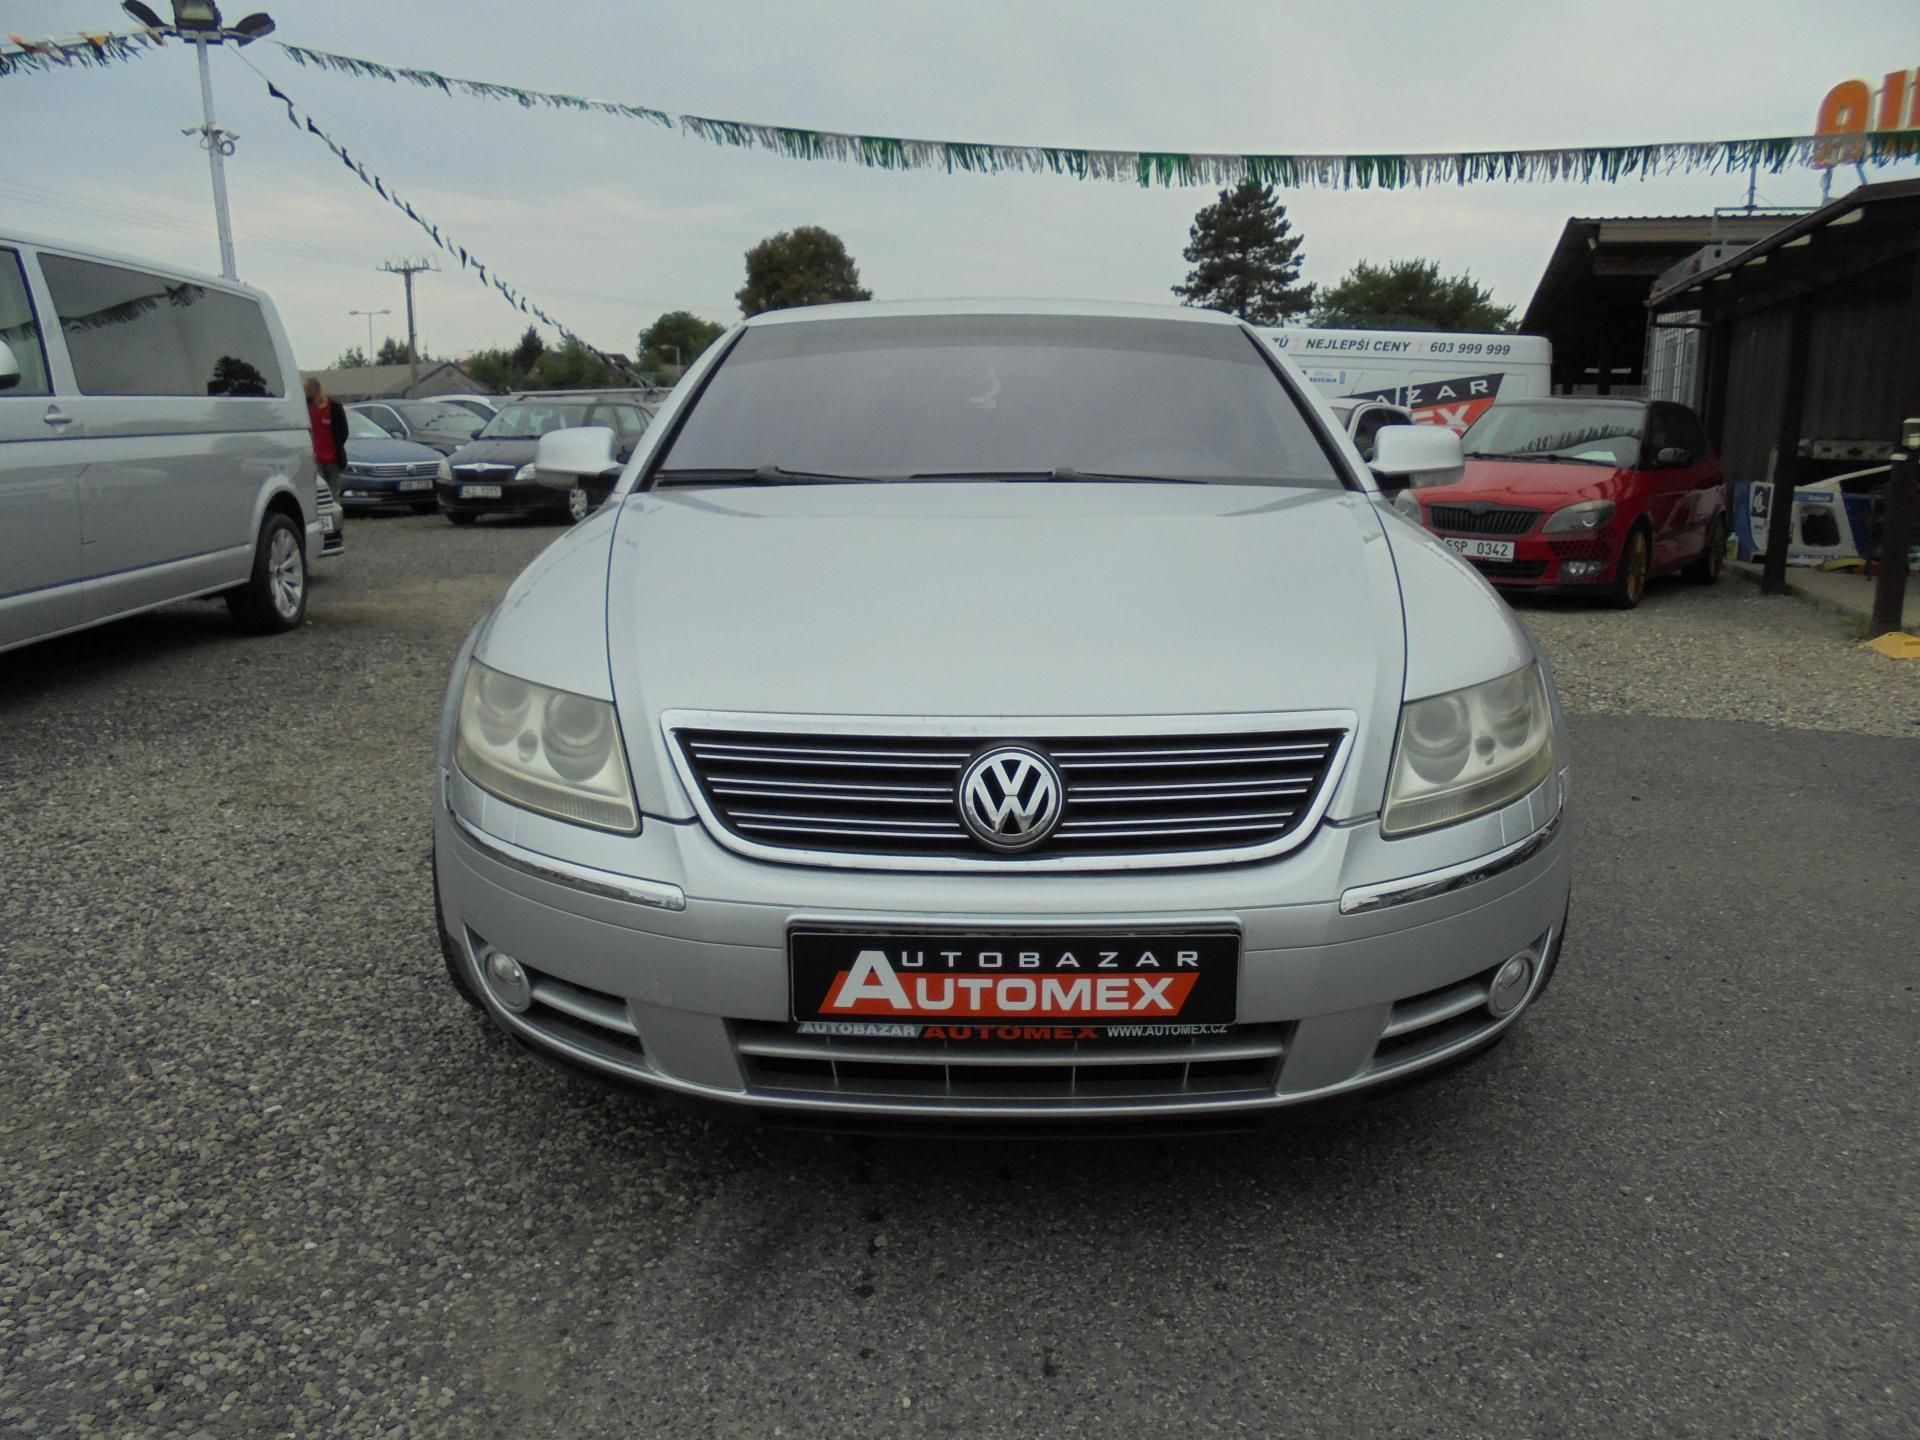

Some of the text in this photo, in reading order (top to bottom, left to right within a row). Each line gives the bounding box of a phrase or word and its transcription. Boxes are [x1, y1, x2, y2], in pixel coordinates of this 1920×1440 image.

[1374, 341, 1411, 352] CENY
[1430, 341, 1454, 353] 603
[1457, 343, 1483, 354] 999
[1486, 344, 1510, 356] 999
[1477, 542, 1508, 556] 0342
[833, 950, 1174, 1011] AUTOMEX
[801, 1023, 1228, 1040] AUTOBAZAR AUTOMEX WWW.AUTOMEX.CZ
